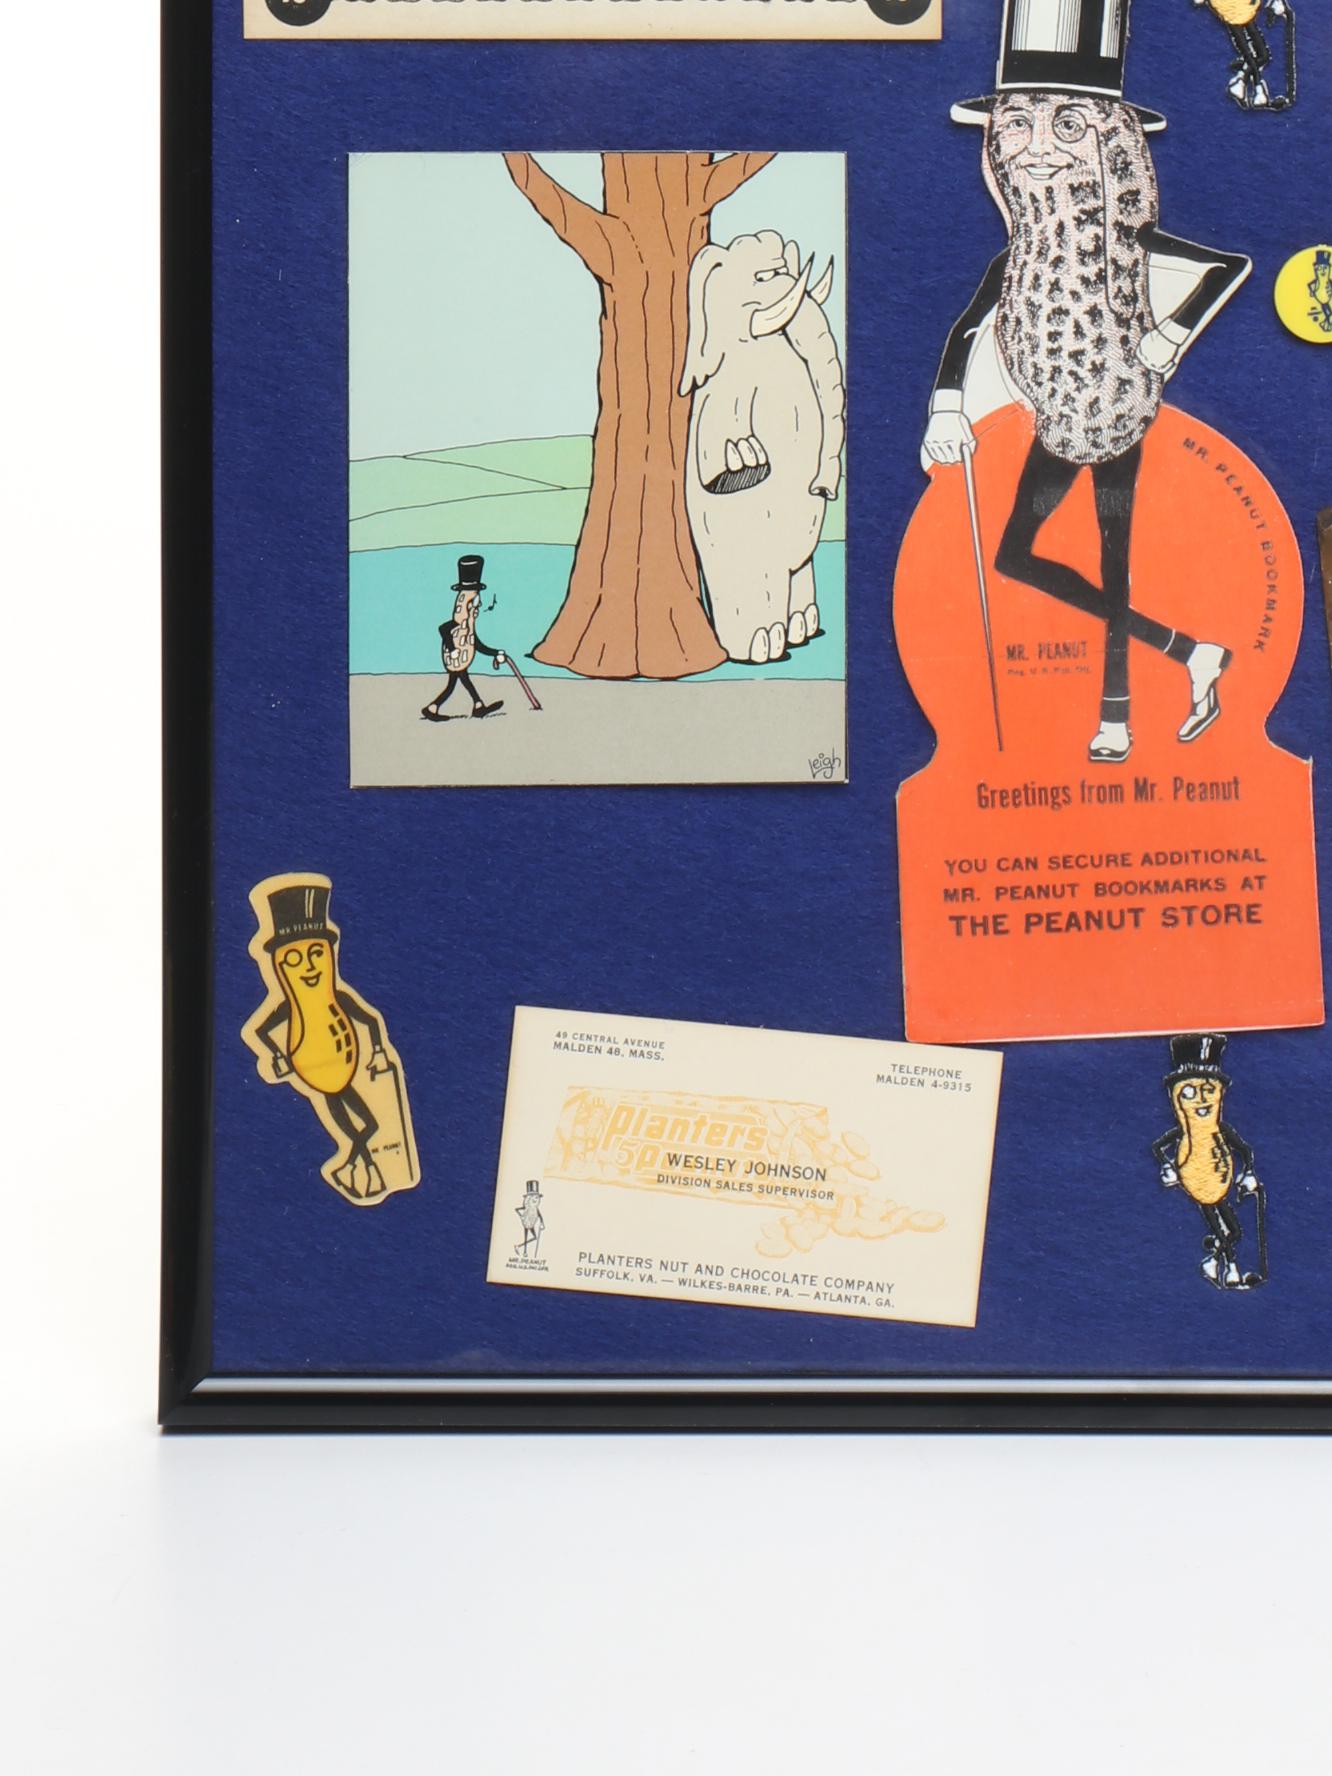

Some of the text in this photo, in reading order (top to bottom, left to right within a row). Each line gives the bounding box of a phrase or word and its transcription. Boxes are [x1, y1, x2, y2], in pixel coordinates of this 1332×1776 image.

[1182, 436, 1280, 652] MR. PEANUT BOOKMARK
[808, 747, 842, 779] Leigh
[976, 776, 1240, 811] Greetings from Mr. Peanut
[944, 848, 1268, 876] YOU CAN SECURE ADDITIONAL
[943, 875, 1267, 903] MR. PEANUT BOOKMARKS AT
[279, 922, 325, 936] MR PEANUT
[948, 903, 1262, 937] THE PEANUT STORE
[555, 1031, 665, 1050] 49 CENTRAL AVENUE
[876, 1074, 972, 1093] MALDEN 4-9315
[890, 1063, 962, 1080] TELEPHONE
[600, 1104, 769, 1153] Planters
[666, 1152, 827, 1182] WESLEY JOHNSON
[656, 1173, 834, 1200] DIVISION SALES SUPERVISOR
[578, 1251, 895, 1294] PLANTERS NUT AND CHOCOLATE COMPANY
